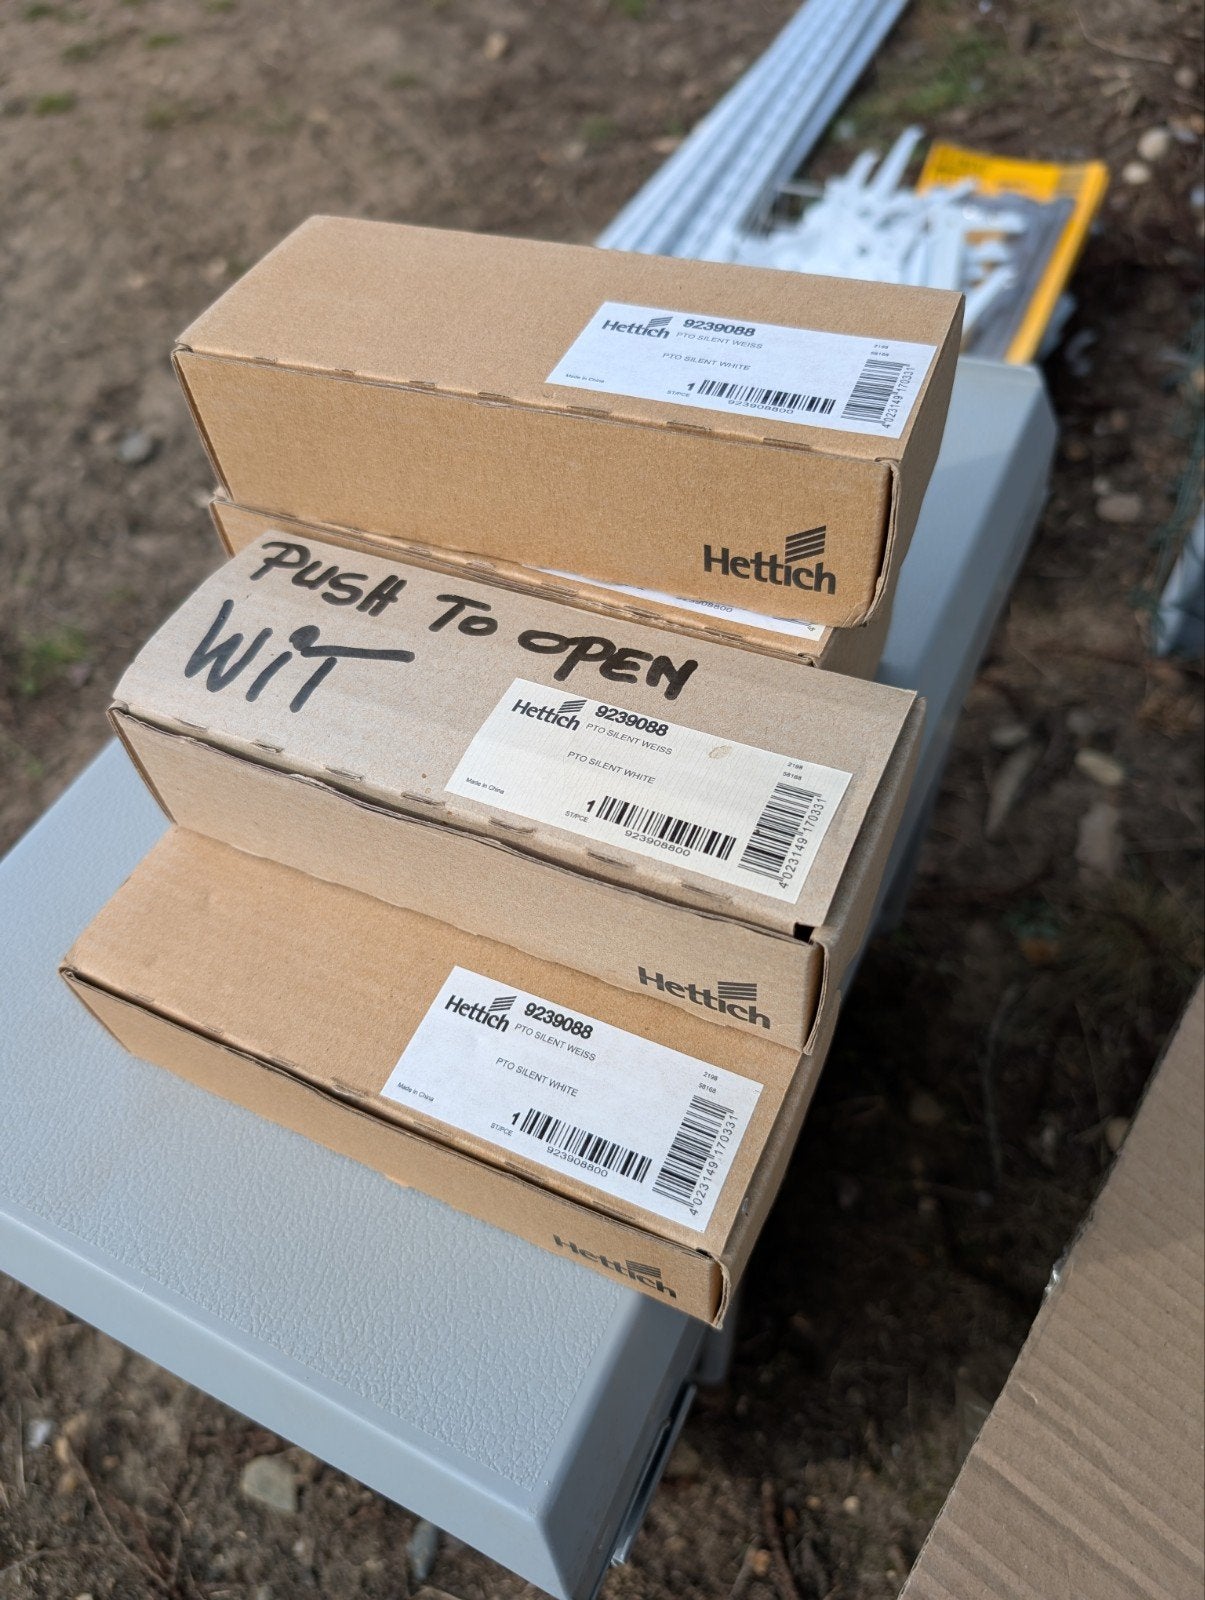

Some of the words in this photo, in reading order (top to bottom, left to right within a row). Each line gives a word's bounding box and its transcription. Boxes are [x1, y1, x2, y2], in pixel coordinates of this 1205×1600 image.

[602, 319, 671, 339] Hettich
[683, 318, 756, 337] 9239088
[697, 335, 730, 345] SILENT
[732, 340, 764, 350] WEISS
[662, 352, 682, 360] PTO
[684, 355, 717, 367] SILENT
[719, 361, 752, 371] WHITE
[687, 382, 696, 391] 1
[727, 400, 794, 415] 923908800
[250, 541, 408, 617] PUSH
[704, 544, 836, 595] Hettich
[511, 699, 581, 731] Hettich
[594, 705, 669, 737] 9239088
[586, 723, 605, 734] PTO
[606, 729, 641, 745] SILENT
[642, 739, 673, 755] WEISS
[567, 751, 587, 763] PTO
[588, 758, 623, 773] SILENT
[624, 768, 656, 785] WHITE
[587, 799, 596, 812] 1
[624, 829, 691, 857] 923908800
[445, 994, 511, 1033] Hettich
[638, 966, 771, 1030] Hettich
[524, 1002, 594, 1040] 9239088
[514, 1023, 533, 1036] PTO
[534, 1031, 566, 1049] SILENT
[567, 1044, 596, 1062] WEISS
[496, 1057, 515, 1070] PTO
[516, 1065, 549, 1084] SILENT
[550, 1080, 579, 1098] WHITE
[511, 1111, 521, 1126] 1
[546, 1145, 609, 1178] 923908800
[552, 1233, 677, 1299] Hettich
